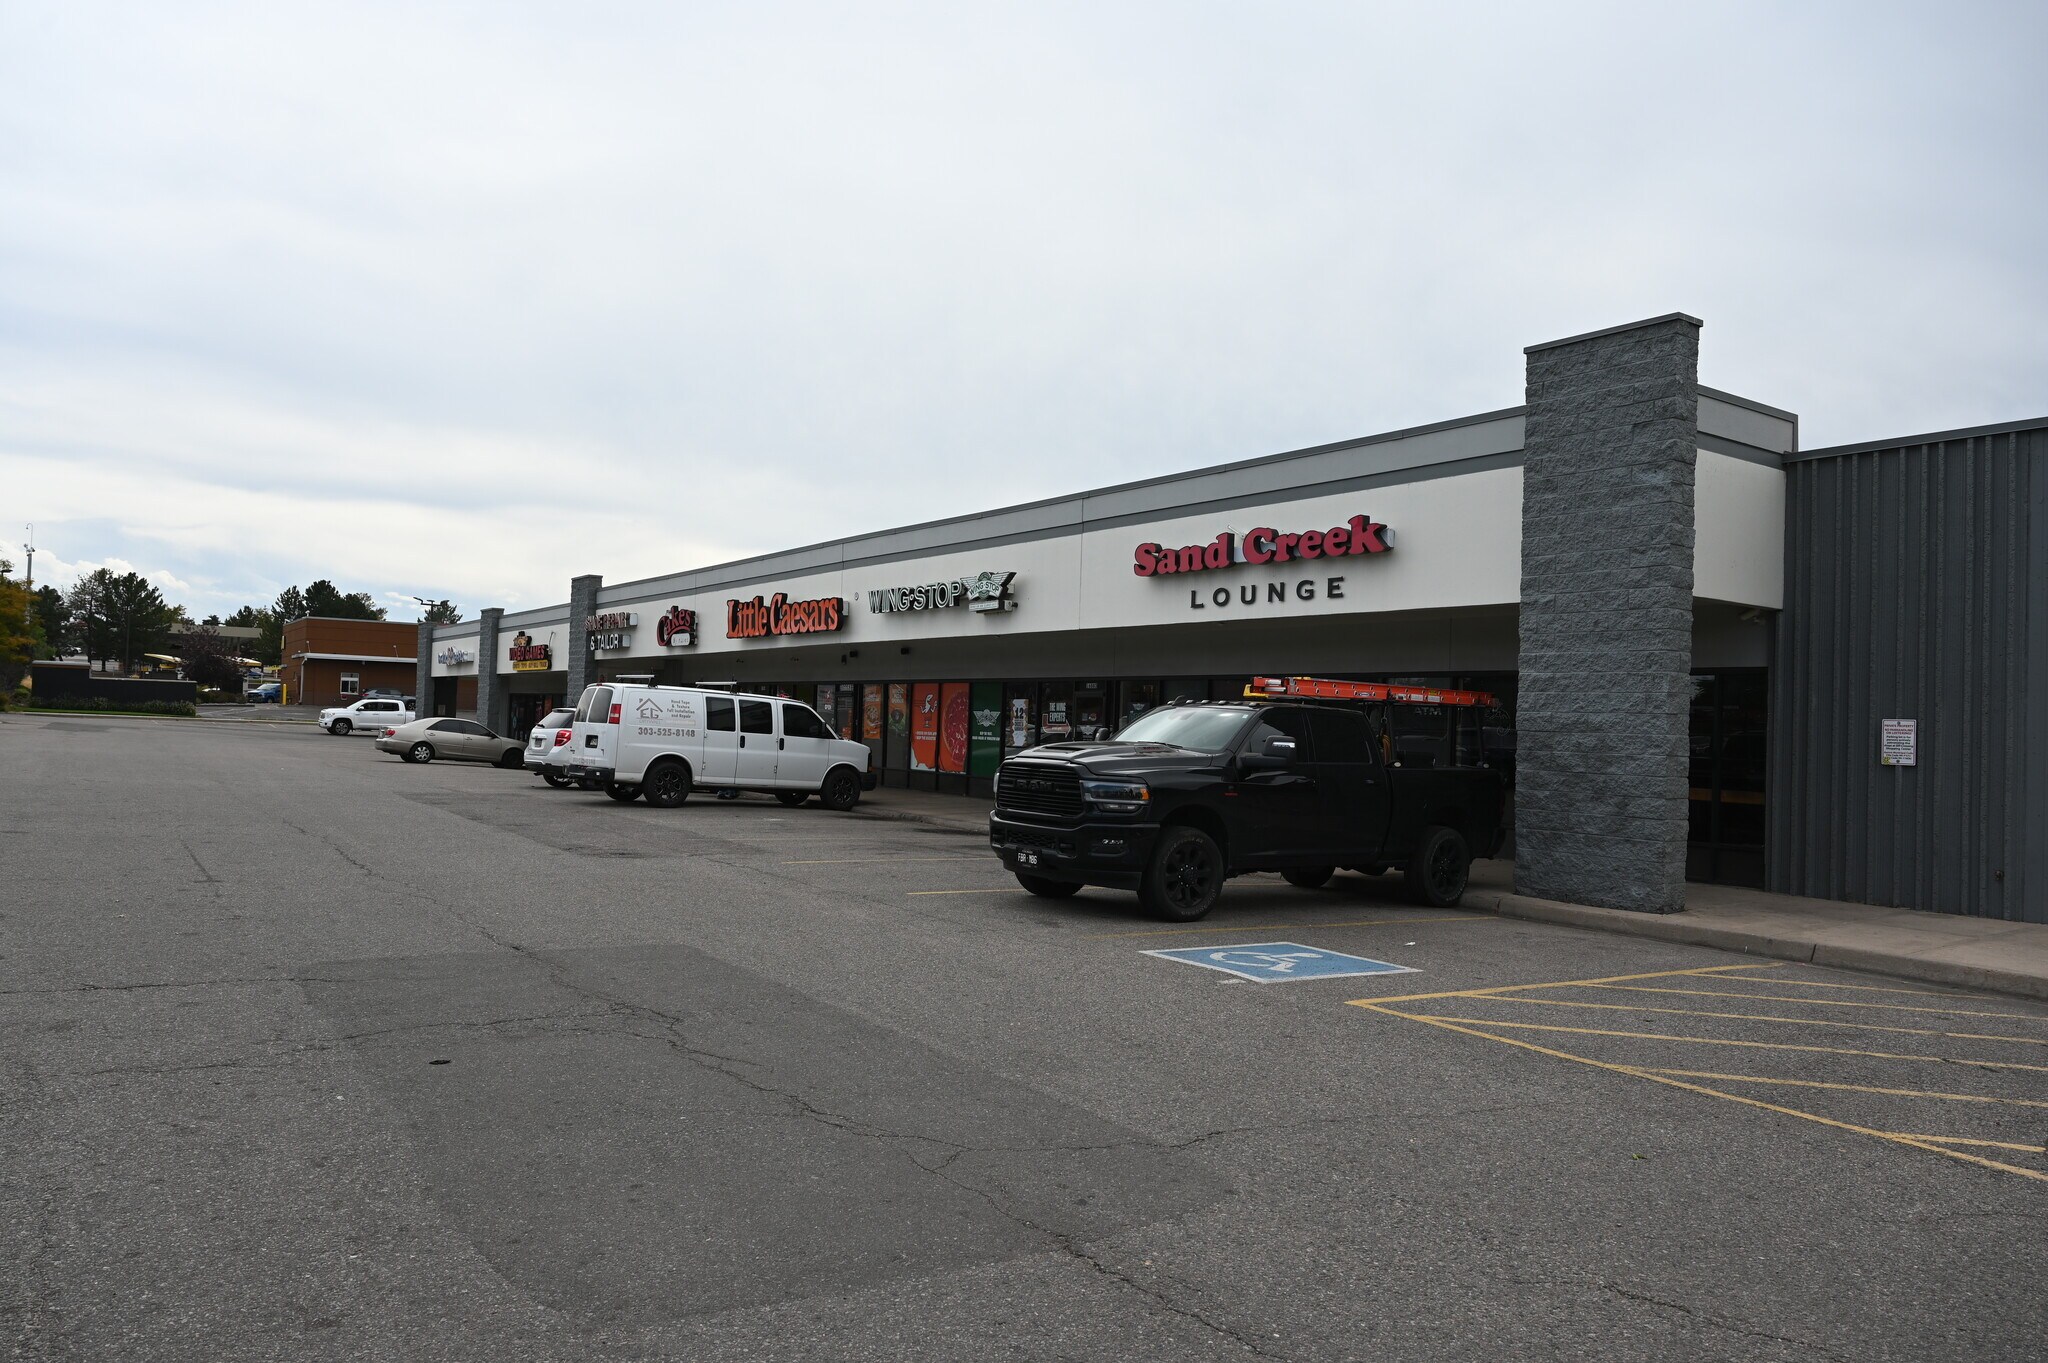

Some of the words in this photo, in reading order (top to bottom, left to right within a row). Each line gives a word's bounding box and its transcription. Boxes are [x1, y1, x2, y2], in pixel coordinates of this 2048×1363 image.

[1134, 532, 1234, 577] Sand
[1243, 514, 1388, 565] Creek
[1190, 576, 1345, 609] LOUNGE
[603, 611, 628, 631] REPAIR
[727, 595, 769, 639] Little
[769, 592, 841, 636] Caesars
[657, 606, 696, 647] Cakes
[597, 633, 620, 650] TAILOR
[509, 646, 525, 661] VIDEO
[525, 644, 547, 660] GAMES
[1056, 702, 1066, 712] WING
[1415, 706, 1442, 716] ATM
[1048, 711, 1066, 722] EXPERTS
[638, 727, 696, 738] 303-525-8148
[1016, 779, 1055, 792] RAM
